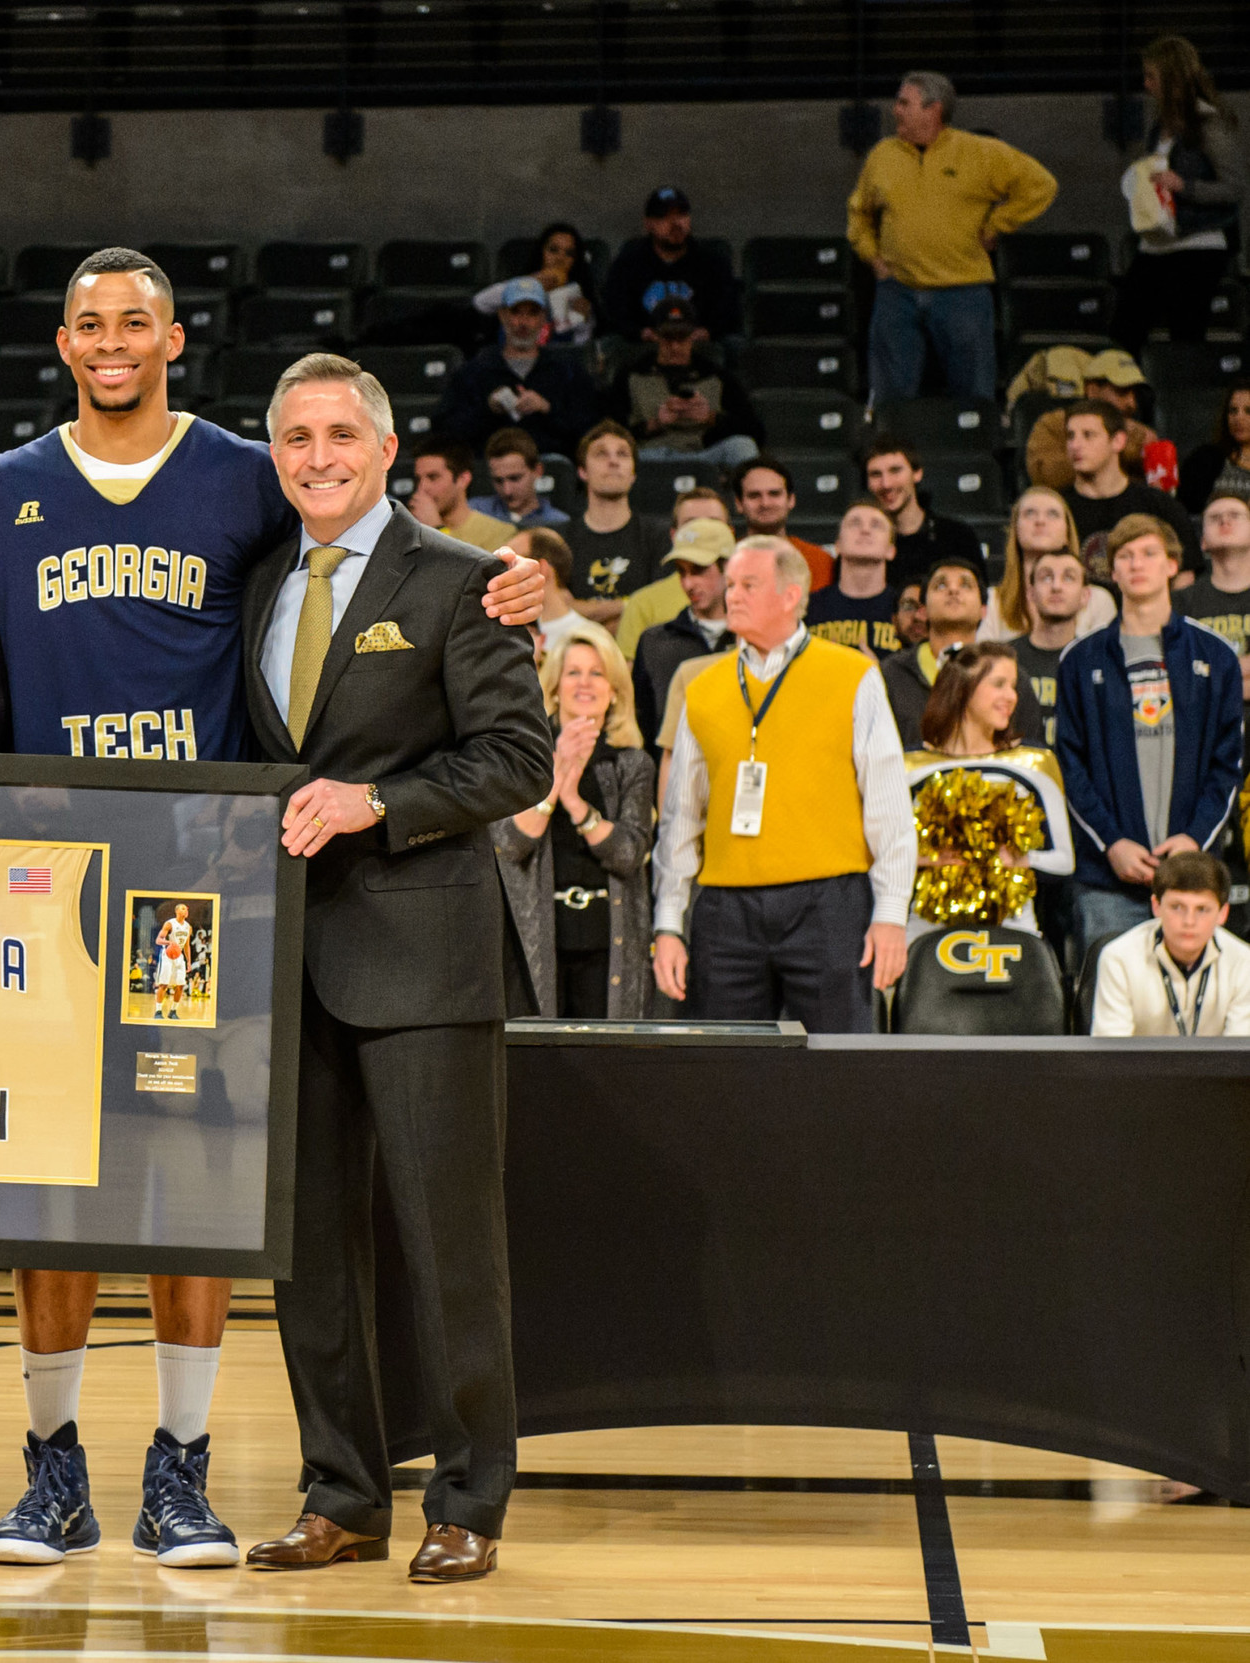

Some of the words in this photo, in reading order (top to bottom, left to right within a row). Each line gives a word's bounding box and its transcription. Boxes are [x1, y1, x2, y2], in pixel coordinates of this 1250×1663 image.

[37, 544, 206, 611] GEORGIA
[61, 709, 197, 760] TECH
[936, 930, 1022, 982] GT
